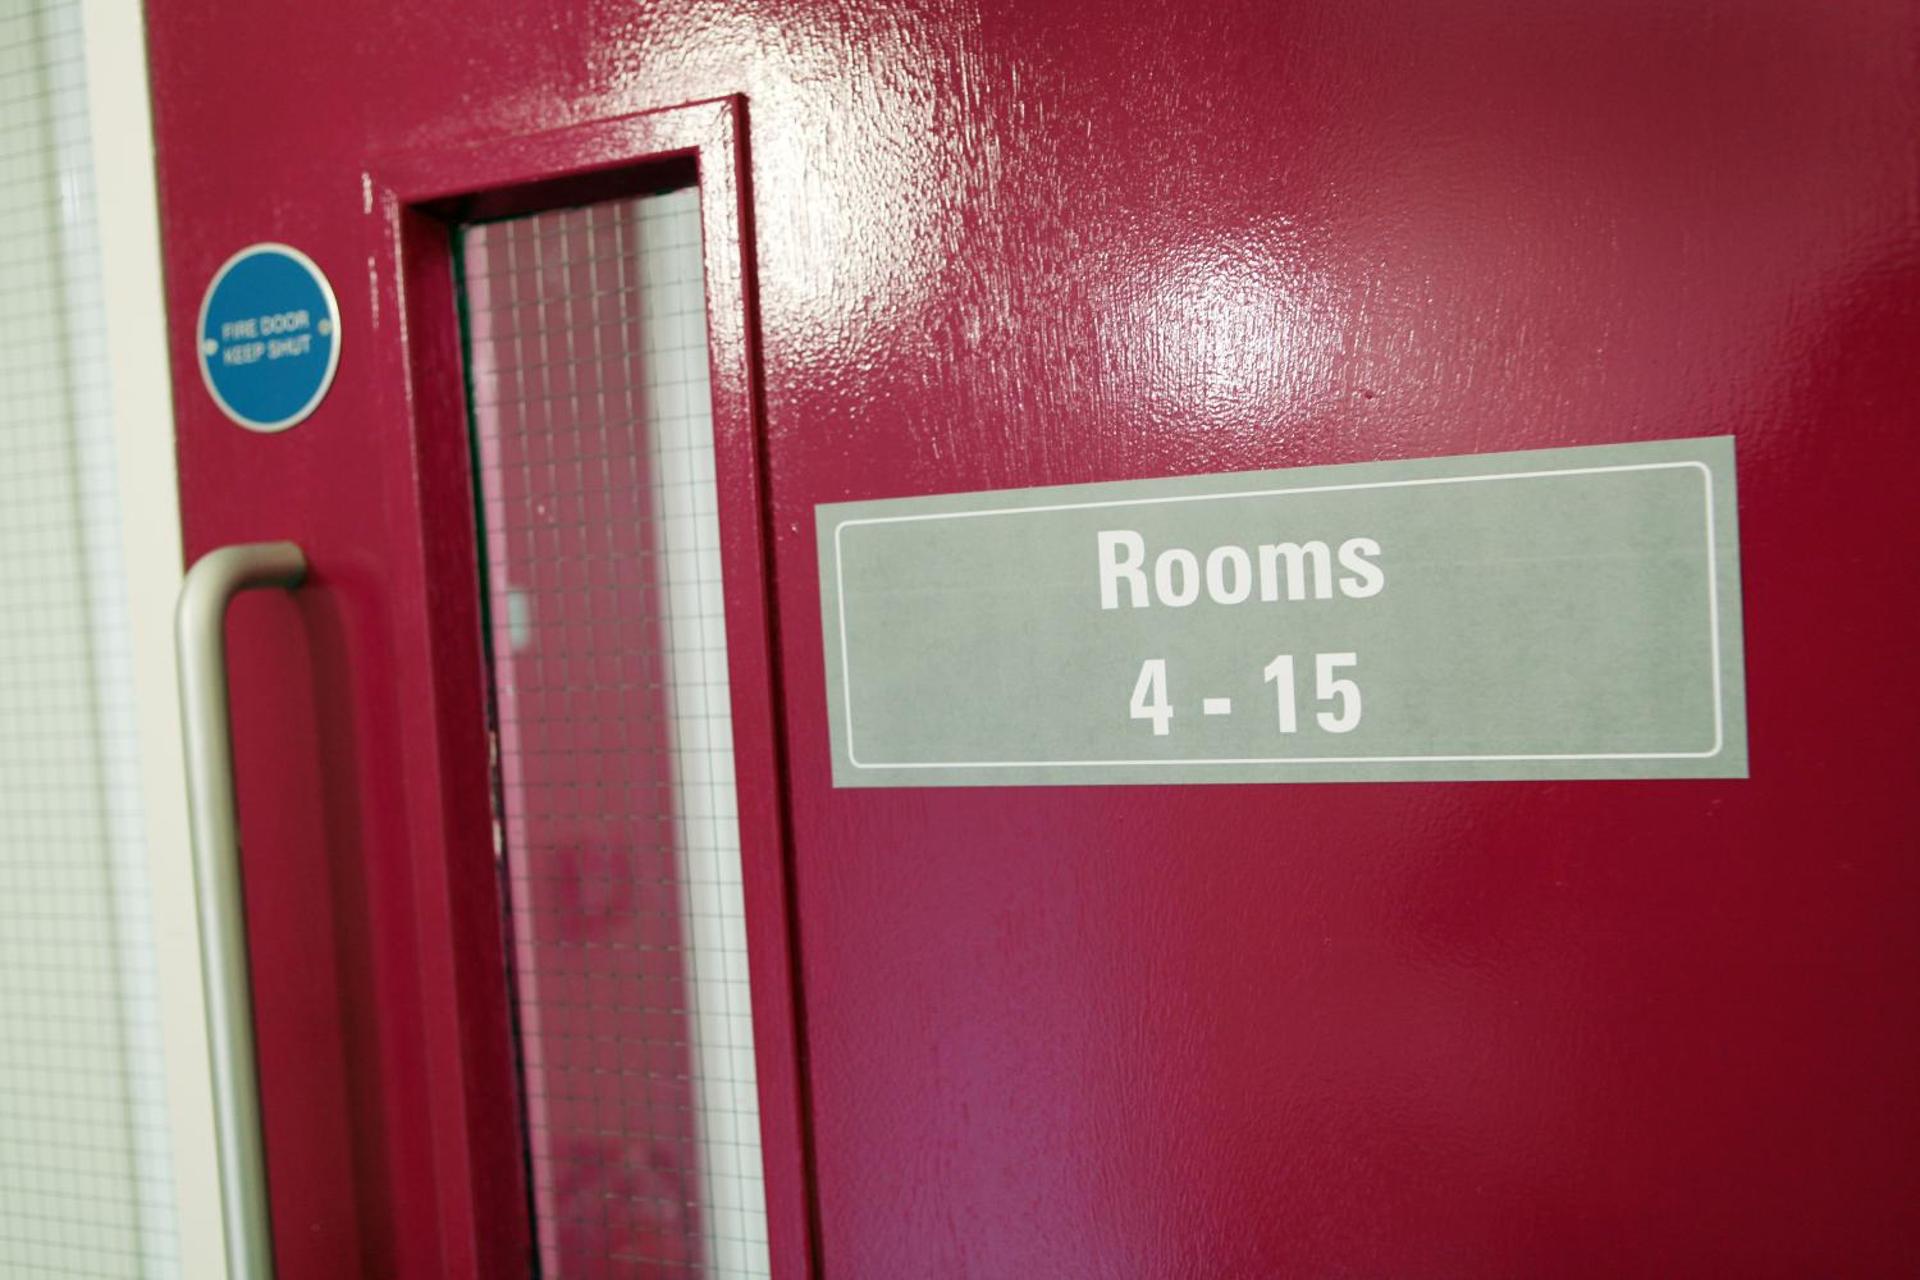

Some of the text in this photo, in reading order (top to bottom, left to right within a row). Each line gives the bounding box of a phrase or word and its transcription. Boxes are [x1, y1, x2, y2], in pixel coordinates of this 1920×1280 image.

[222, 310, 309, 340] FIRE DOOR
[223, 334, 311, 366] KEEP SHUT
[1097, 530, 1385, 610] Rooms
[1130, 652, 1362, 736] 4 - 15
